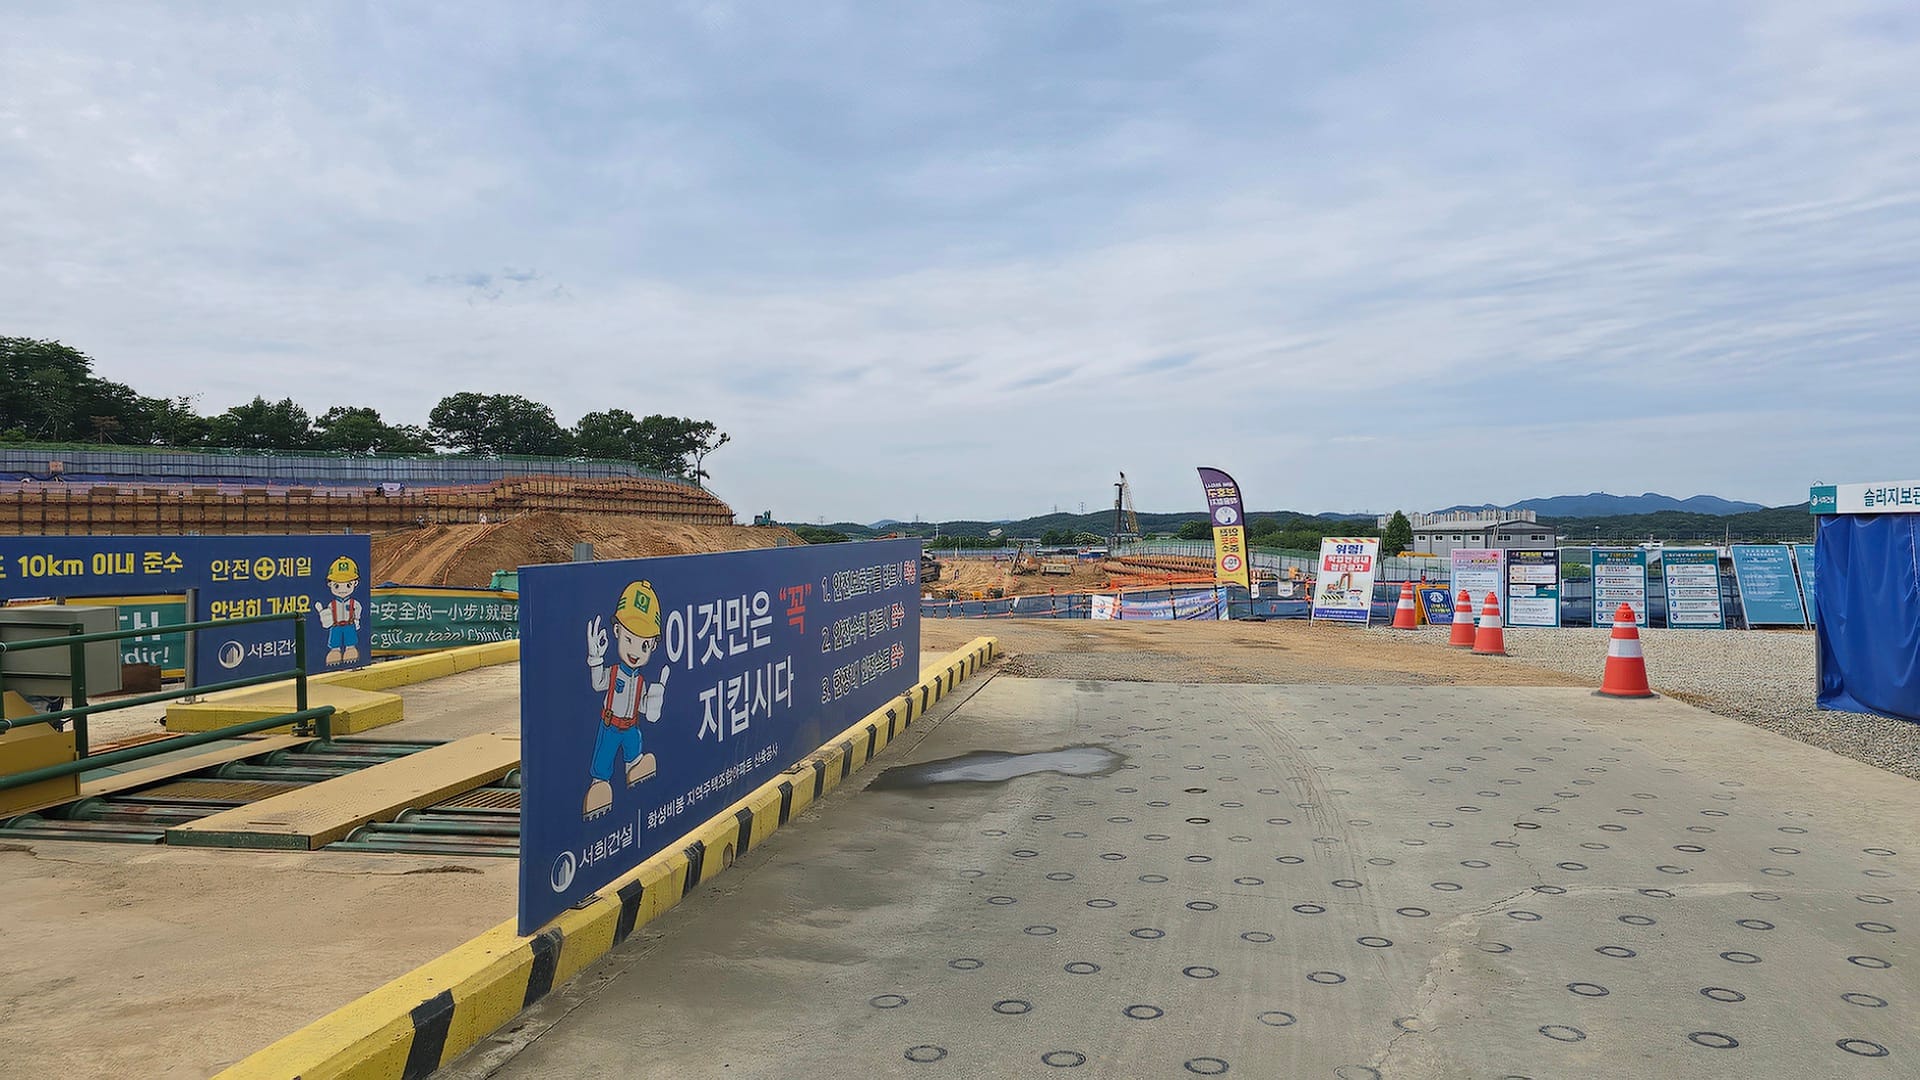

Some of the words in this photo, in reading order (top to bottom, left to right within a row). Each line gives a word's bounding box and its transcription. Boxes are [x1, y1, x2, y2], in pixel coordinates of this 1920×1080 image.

[1336, 544, 1364, 554] 위험!
[17, 554, 84, 578] 10km
[92, 552, 135, 575] 이내
[143, 552, 183, 574] 준수
[211, 559, 250, 581] 안전
[277, 557, 312, 577] 제일
[211, 598, 261, 621] 안녕히
[266, 595, 311, 615] 가세요
[665, 590, 773, 670] 이것만은
[697, 655, 795, 743] 지킵시다
[578, 823, 633, 868] 서희건설
[647, 795, 686, 830] 화성비봉
[686, 758, 753, 807] 지역주택조합아파트
